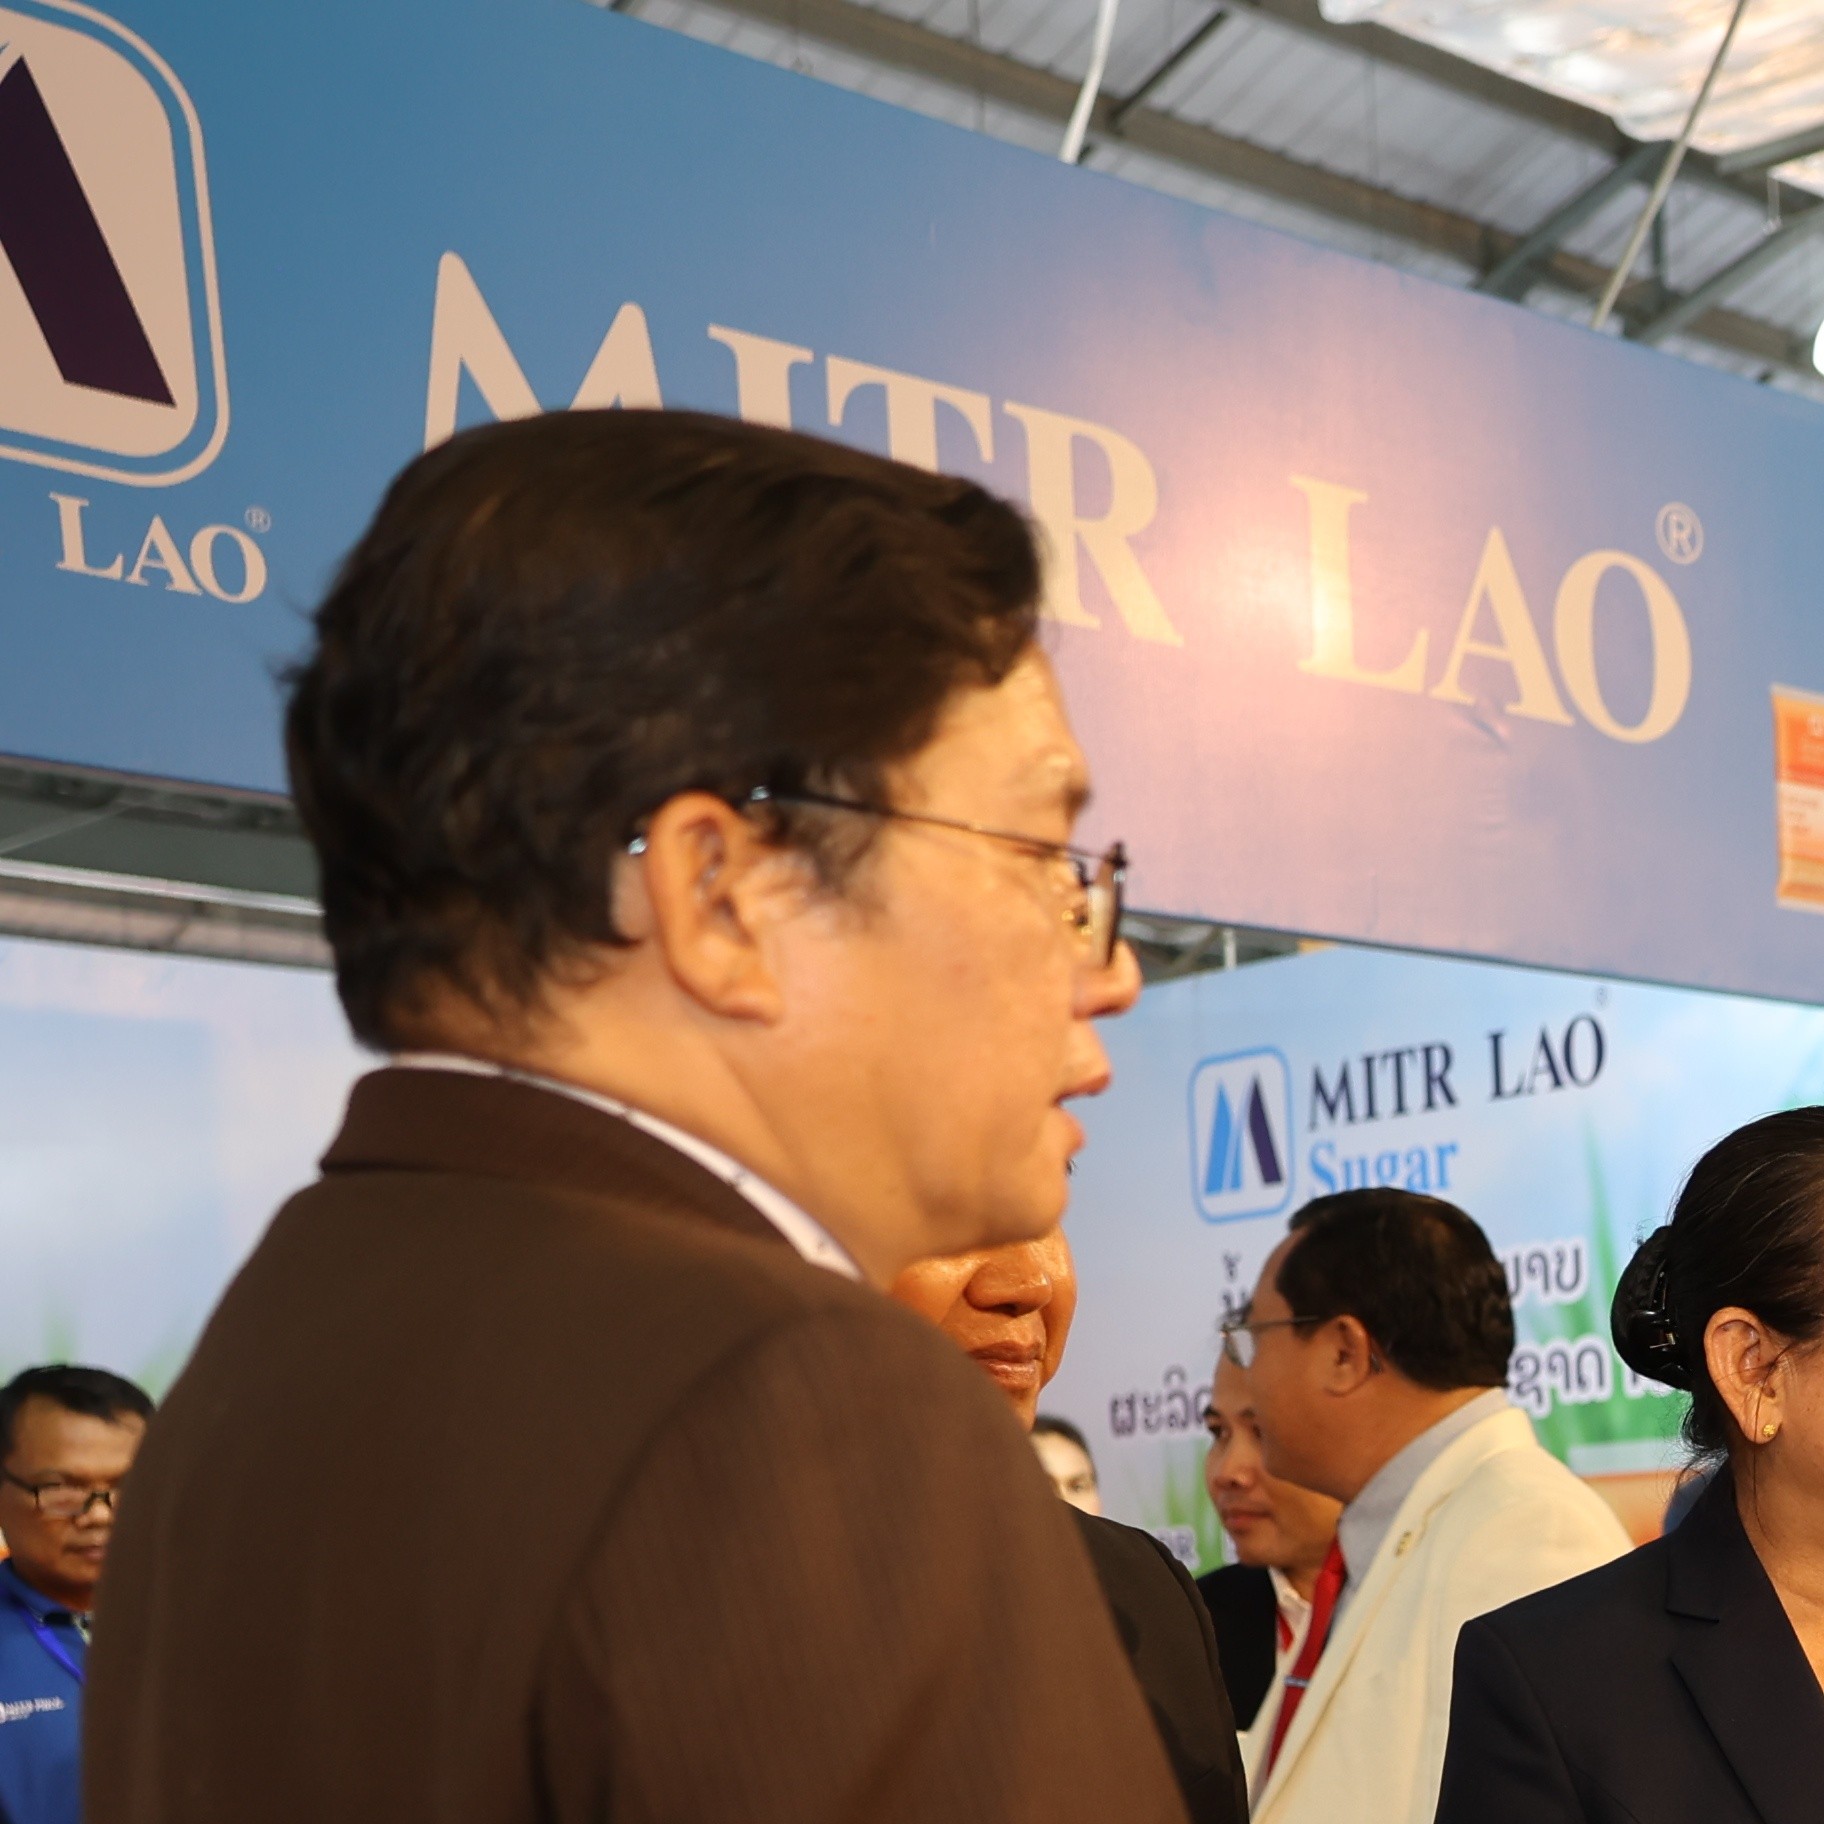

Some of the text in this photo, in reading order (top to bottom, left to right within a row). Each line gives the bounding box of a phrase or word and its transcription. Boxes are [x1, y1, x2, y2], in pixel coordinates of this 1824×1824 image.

[48, 490, 268, 604] LAO
[1290, 473, 1692, 744] LAO
[1307, 1011, 1608, 1133] MITR LAO
[1308, 1137, 1460, 1198] Sugar
